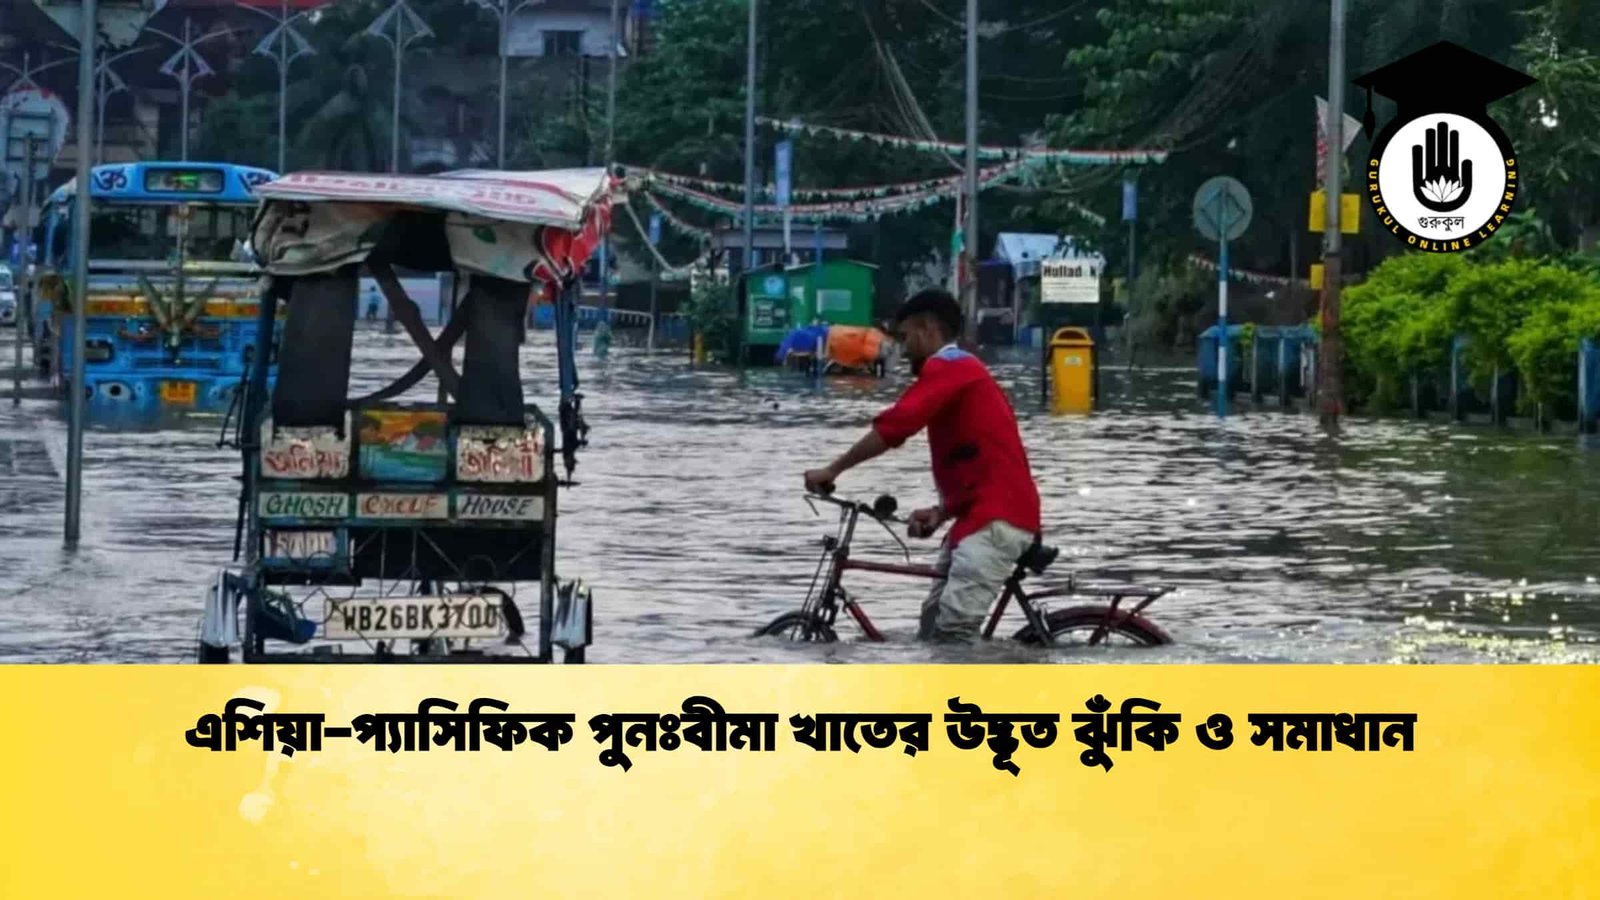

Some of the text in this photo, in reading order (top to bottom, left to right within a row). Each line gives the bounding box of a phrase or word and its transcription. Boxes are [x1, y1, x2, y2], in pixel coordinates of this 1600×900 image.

[265, 494, 344, 516] GHOSH
[460, 495, 534, 516] HOUSE
[342, 602, 498, 632] WB26BK3700
